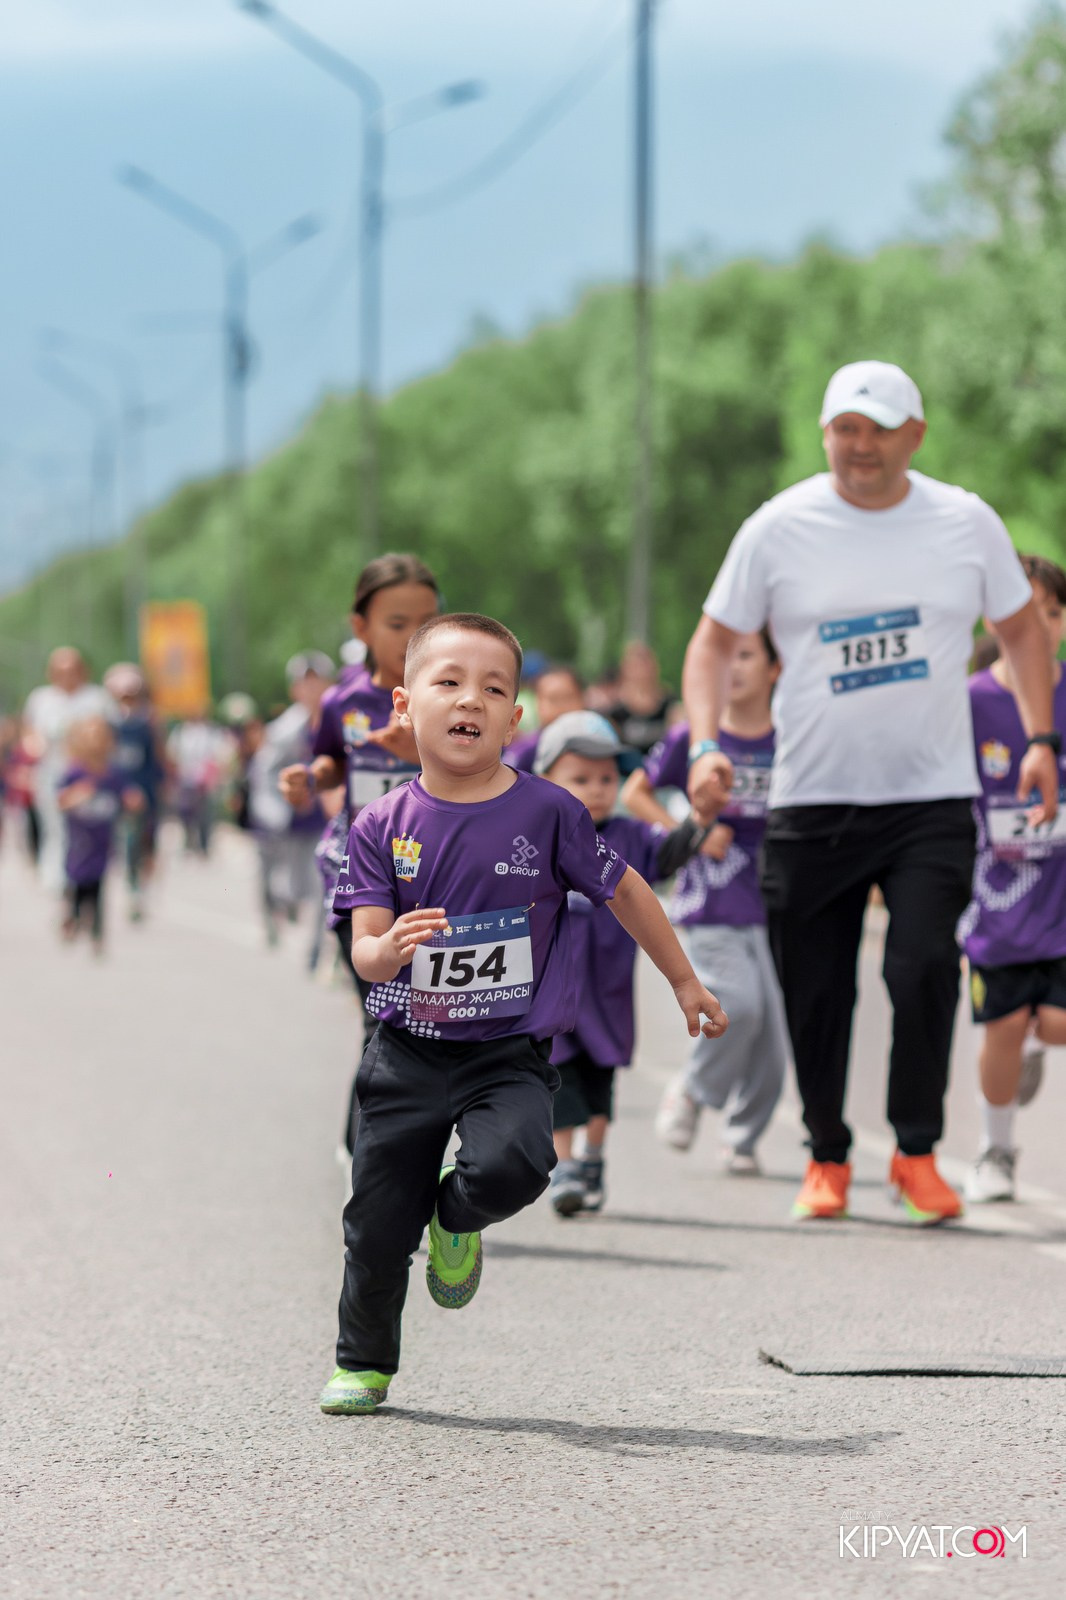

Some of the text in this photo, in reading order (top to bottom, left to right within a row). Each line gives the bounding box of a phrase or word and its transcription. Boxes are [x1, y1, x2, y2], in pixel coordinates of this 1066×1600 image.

[841, 633, 908, 667] 1813
[395, 858, 404, 868] BI
[396, 866, 415, 876] RUN
[509, 866, 540, 877] GROUP
[429, 945, 507, 988] 154
[468, 985, 530, 1005] ЖАРЫСЫ
[447, 1006, 477, 1019] 600
